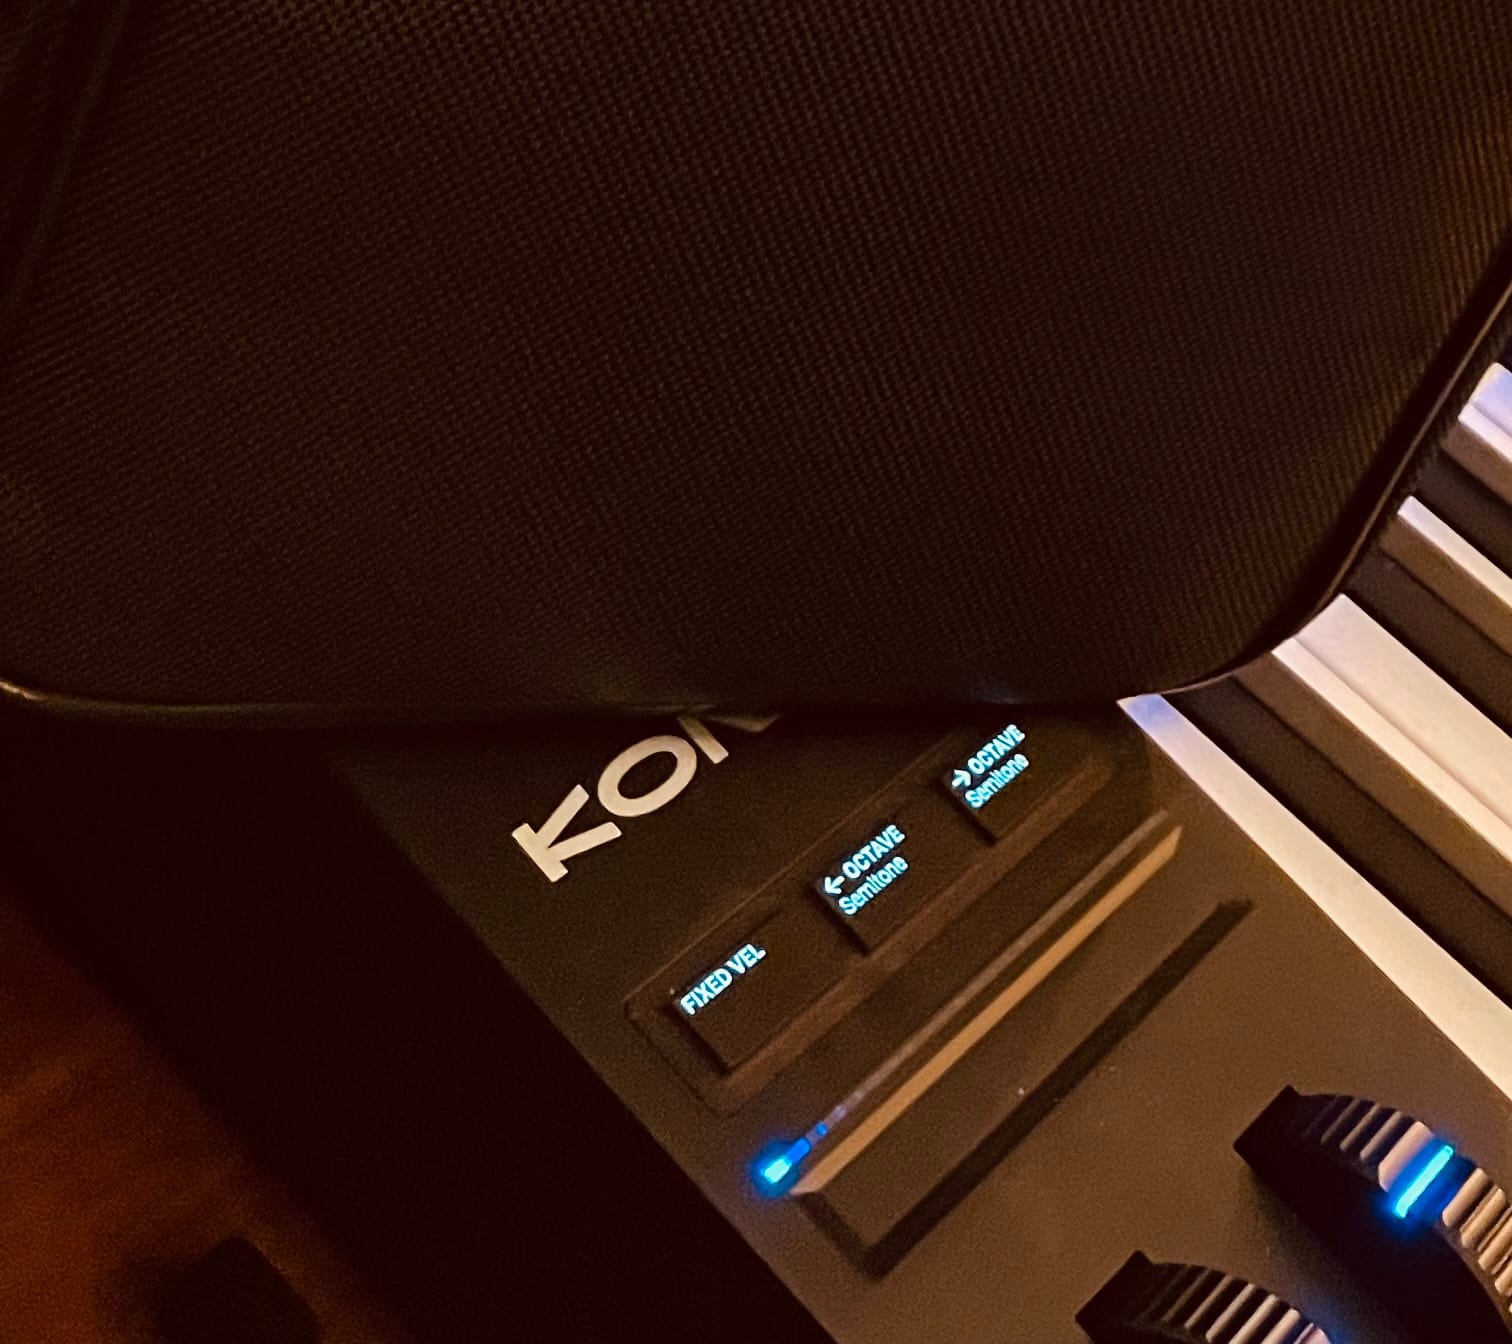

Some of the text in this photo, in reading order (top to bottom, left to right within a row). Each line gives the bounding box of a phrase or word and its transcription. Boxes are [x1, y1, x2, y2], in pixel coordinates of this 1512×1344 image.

[967, 724, 1026, 775] OCTAVE
[964, 753, 1030, 809] Semitone
[842, 824, 906, 879] OCTAVE
[838, 856, 909, 915] Semitone
[680, 943, 767, 1015] FIXED VEL
